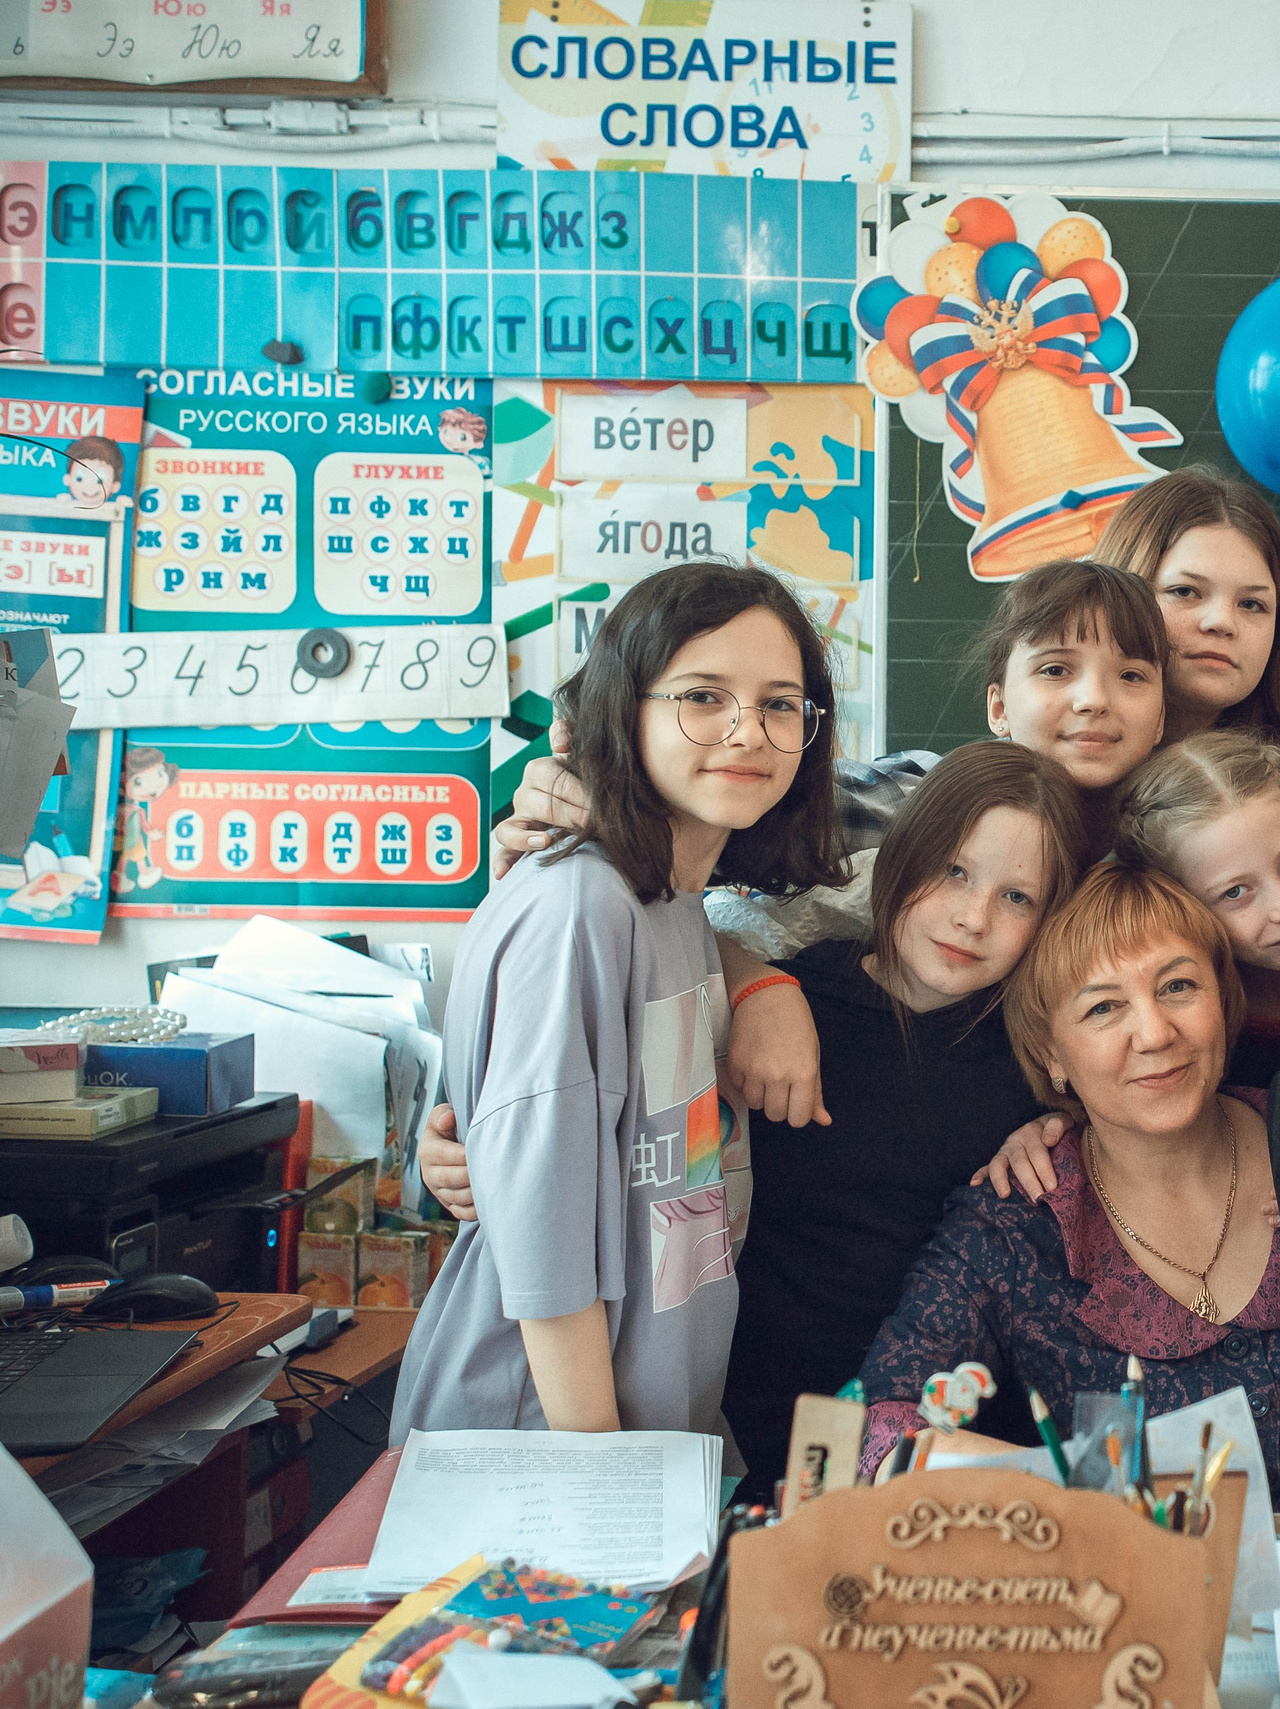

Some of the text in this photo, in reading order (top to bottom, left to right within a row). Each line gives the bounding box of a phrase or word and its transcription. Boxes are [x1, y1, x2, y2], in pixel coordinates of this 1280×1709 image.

[97, 22, 135, 58] Ээ
[181, 23, 242, 59] Юю
[292, 24, 344, 59] Яя
[511, 35, 897, 84] СЛОВАРНЫЕ
[600, 103, 808, 150] СЛОВА
[7, 201, 37, 236] э
[64, 204, 94, 238] н
[119, 207, 157, 239] м
[174, 207, 211, 241] л
[236, 207, 270, 252] р
[349, 200, 382, 247] б
[408, 215, 436, 249] в
[458, 214, 479, 249] г
[498, 212, 531, 253] д
[543, 210, 584, 248] ж
[601, 210, 629, 249] з
[7, 300, 852, 365] е п ф к т ш с х ц ч щ
[136, 369, 475, 400] СОГЛАСНЫЕ ВУКИ
[179, 409, 433, 436] РУССКОГО ЯЗЫКА
[155, 459, 265, 477] ЗВОНКИЕ
[353, 464, 445, 480] ГЛУХИЕ
[140, 488, 284, 516] б в г д
[330, 495, 469, 519] п ф к т
[21, 540, 90, 557] ЗВУКИ
[137, 528, 282, 553] ж з й л
[328, 535, 468, 557] ш с х ц
[163, 570, 267, 593] р н м
[369, 574, 429, 597] ч щ
[58, 648, 85, 699] 2
[107, 646, 147, 698] 3
[175, 645, 205, 696] 4
[228, 643, 267, 696] 5
[359, 640, 384, 692] 7
[400, 639, 439, 691] 8
[460, 635, 497, 689] 9
[180, 781, 449, 803] ПАРНЫЕ СОГЛАСНЫЕ
[176, 815, 452, 842] б в г д ж з
[176, 843, 453, 867] п ф к т ш с
[631, 1131, 681, 1188] 虹
